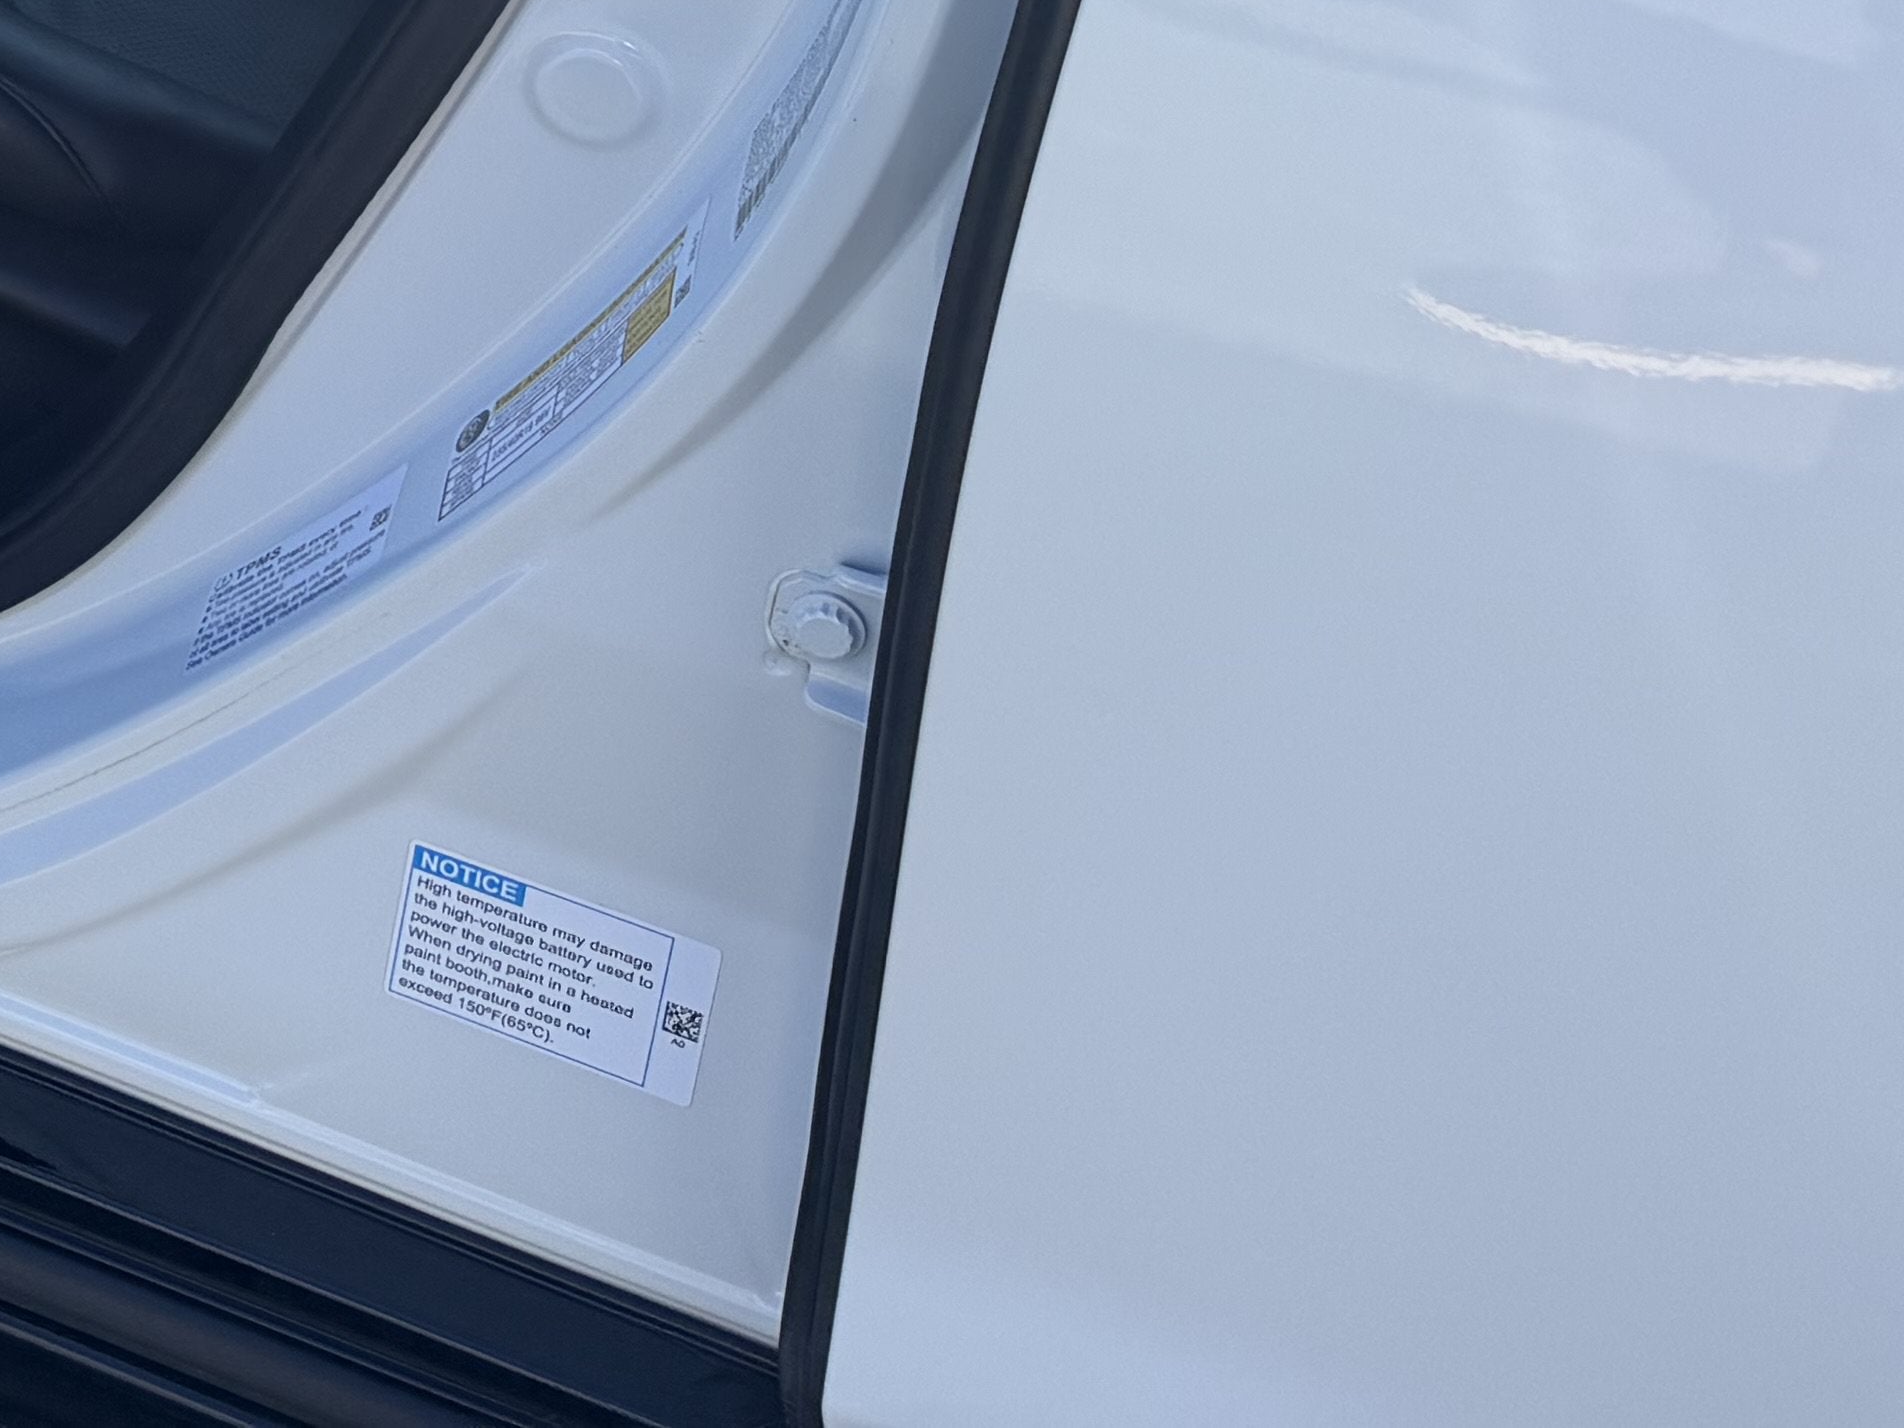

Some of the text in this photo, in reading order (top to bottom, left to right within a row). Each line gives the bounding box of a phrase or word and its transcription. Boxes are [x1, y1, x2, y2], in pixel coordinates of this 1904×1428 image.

[236, 546, 282, 581] TPMS
[419, 850, 519, 902] NOTICE
[410, 910, 596, 988] power the electric motor.
[414, 892, 655, 991] the high-voltage battery used to
[417, 875, 653, 973] High temperature may damage
[398, 976, 452, 1007] exceed
[401, 958, 592, 1041] the temperature does not
[404, 942, 442, 970] paint
[538, 993, 572, 1014] sure
[408, 926, 635, 1020] When drying paint in a heated
